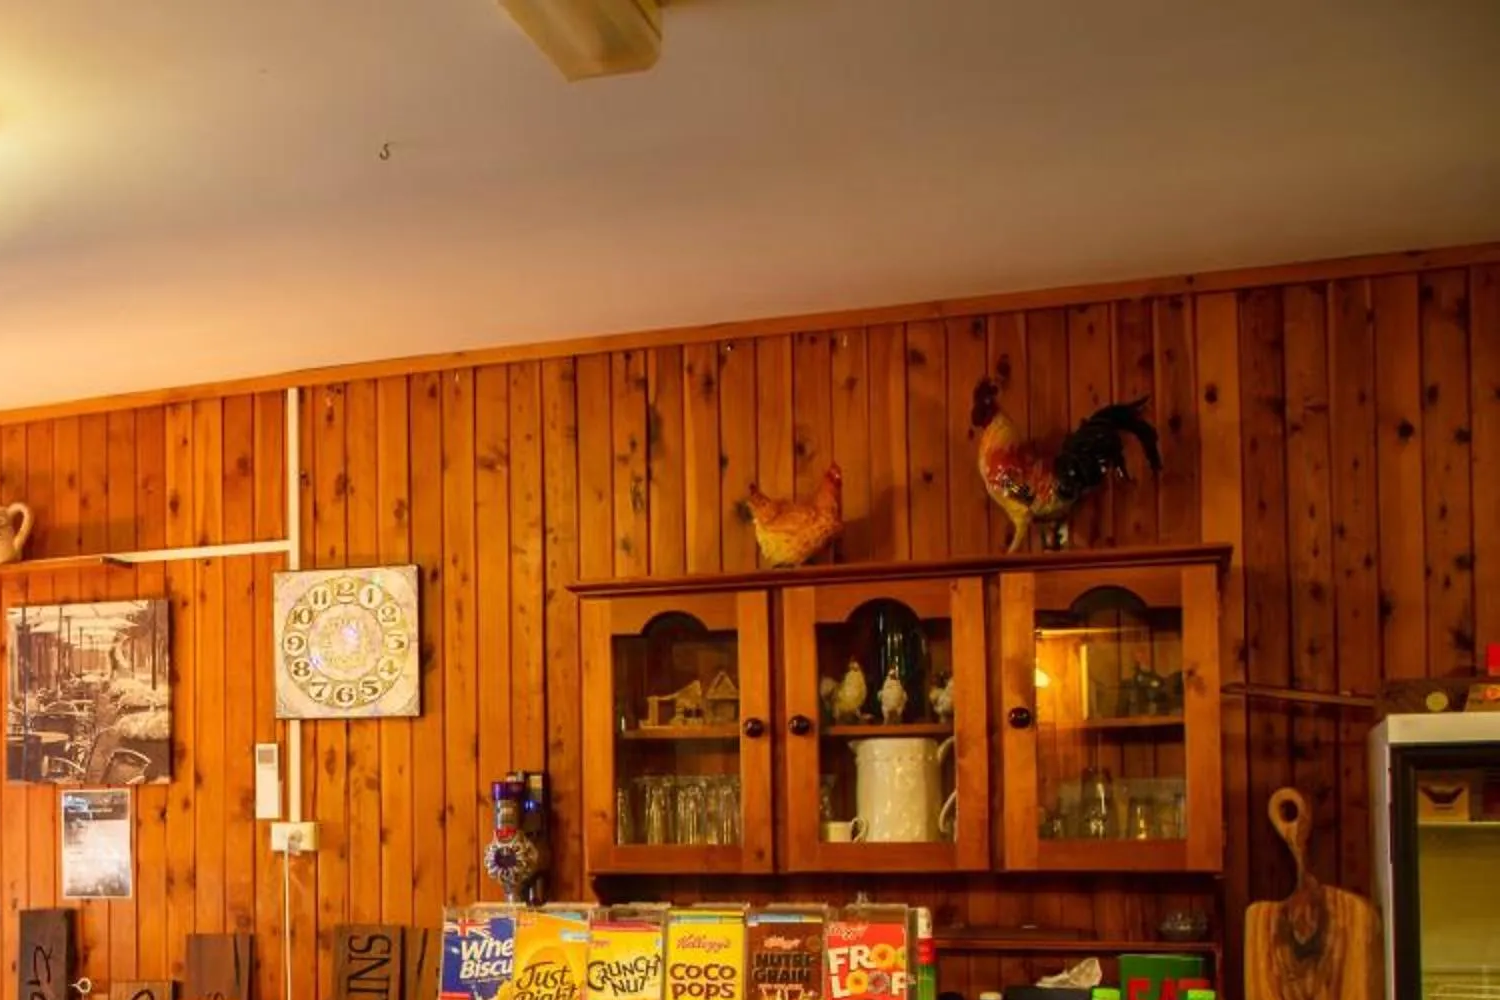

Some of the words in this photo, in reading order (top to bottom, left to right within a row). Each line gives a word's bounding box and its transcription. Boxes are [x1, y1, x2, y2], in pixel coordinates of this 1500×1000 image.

[312, 589, 328, 606] 11
[364, 586, 377, 604] 1
[292, 606, 314, 625] 10
[380, 605, 398, 623] 2
[286, 634, 305, 651] 9
[292, 660, 312, 677] 8
[379, 659, 399, 676] 4
[311, 681, 329, 699] 7
[335, 686, 355, 703] 6
[360, 680, 379, 697] 5
[516, 961, 570, 990] Just
[669, 963, 737, 981] COCO
[753, 969, 810, 983] GRAIN
[611, 975, 651, 997] NUT
[671, 982, 735, 1000] POPS
